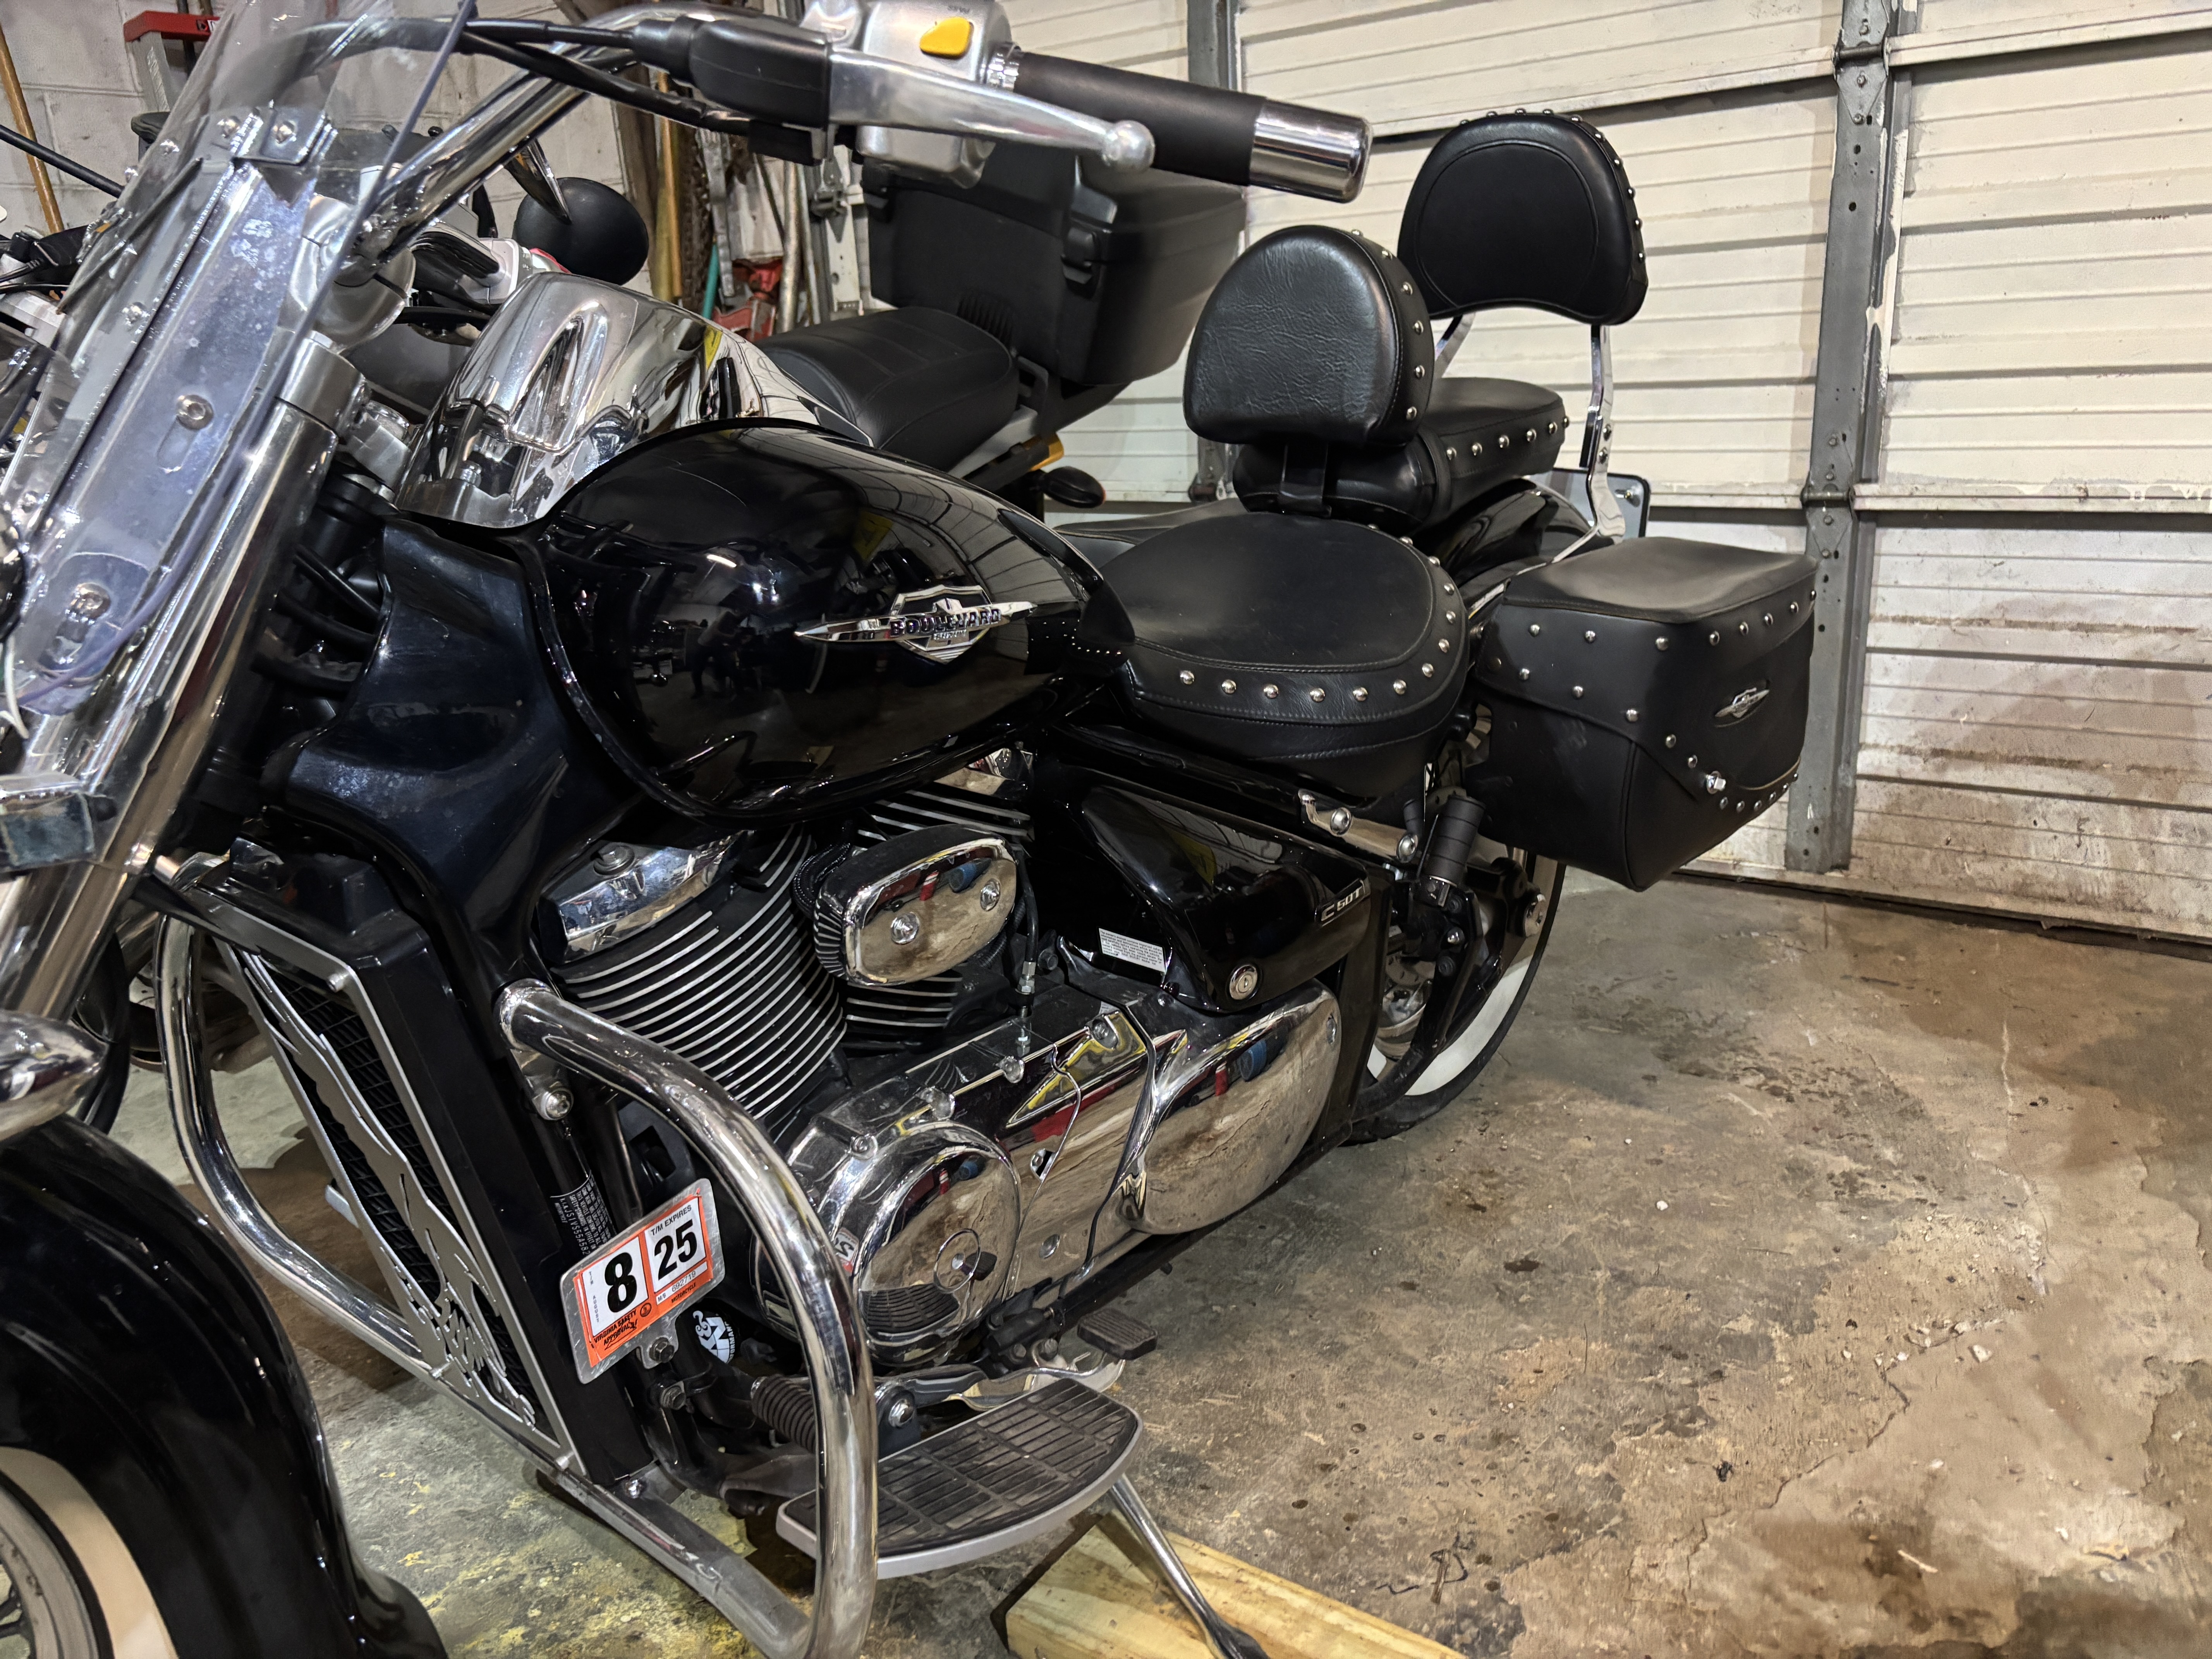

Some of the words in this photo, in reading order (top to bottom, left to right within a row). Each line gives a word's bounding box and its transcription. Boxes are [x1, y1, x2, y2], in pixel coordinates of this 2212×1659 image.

[890, 608, 1001, 637] BOULEVARD
[1321, 904, 1335, 921] C
[665, 1204, 692, 1227] EXPIRES
[654, 1219, 697, 1281] 25
[604, 1252, 637, 1313] 8
[672, 1270, 696, 1292] 692719
[671, 1282, 696, 1304] MOTORCYCLE
[594, 1323, 617, 1343] VIRGINIA
[618, 1309, 637, 1327] SAFETY
[604, 1323, 630, 1345] APPROVAL
